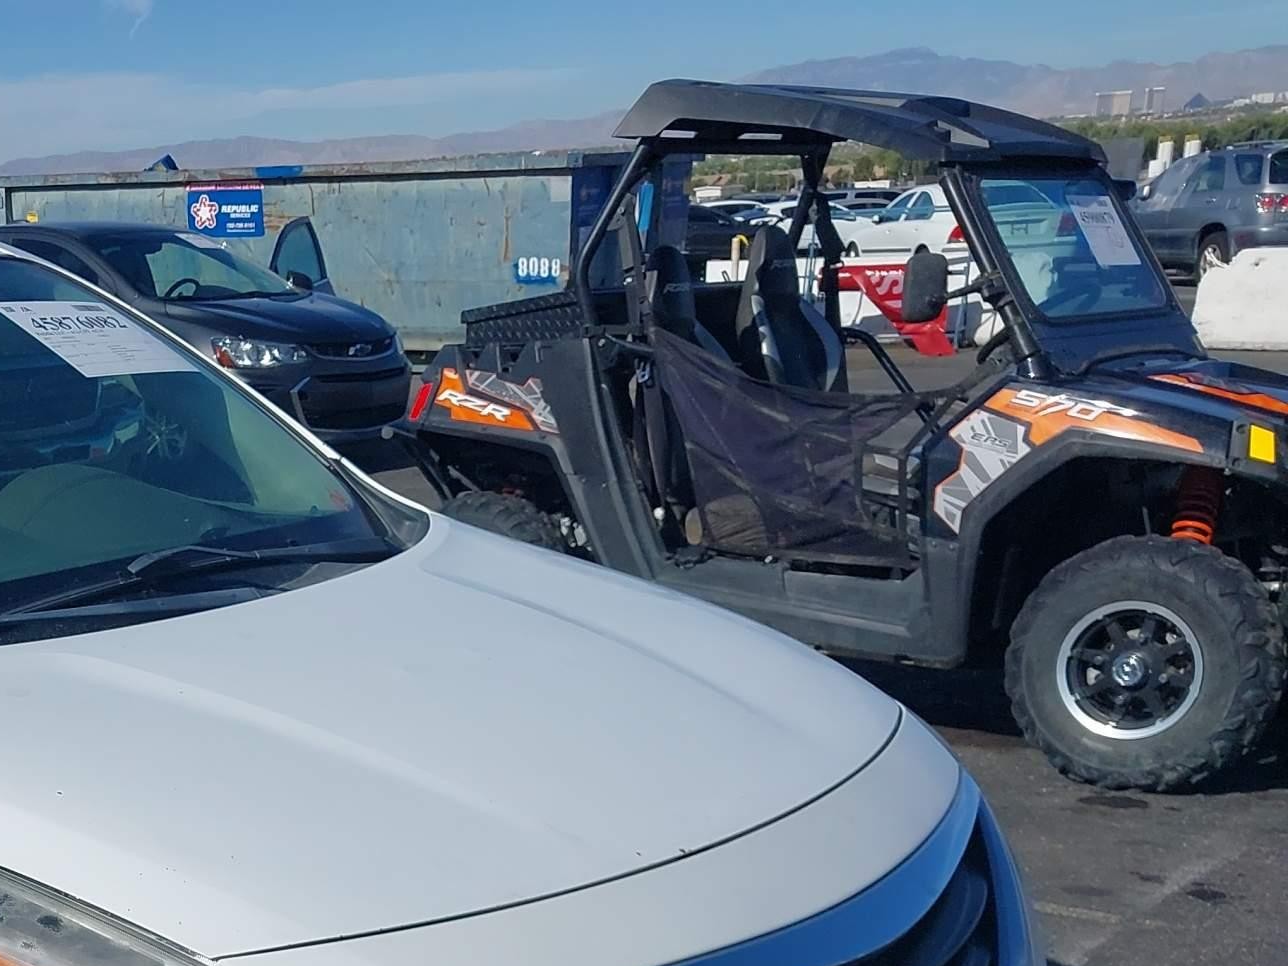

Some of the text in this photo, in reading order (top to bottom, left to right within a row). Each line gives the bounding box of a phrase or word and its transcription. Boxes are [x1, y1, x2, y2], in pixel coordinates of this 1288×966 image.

[221, 204, 259, 213] REPUBLIC
[518, 256, 561, 278] 8088
[30, 316, 129, 332] 45876082
[436, 389, 511, 422] RZR
